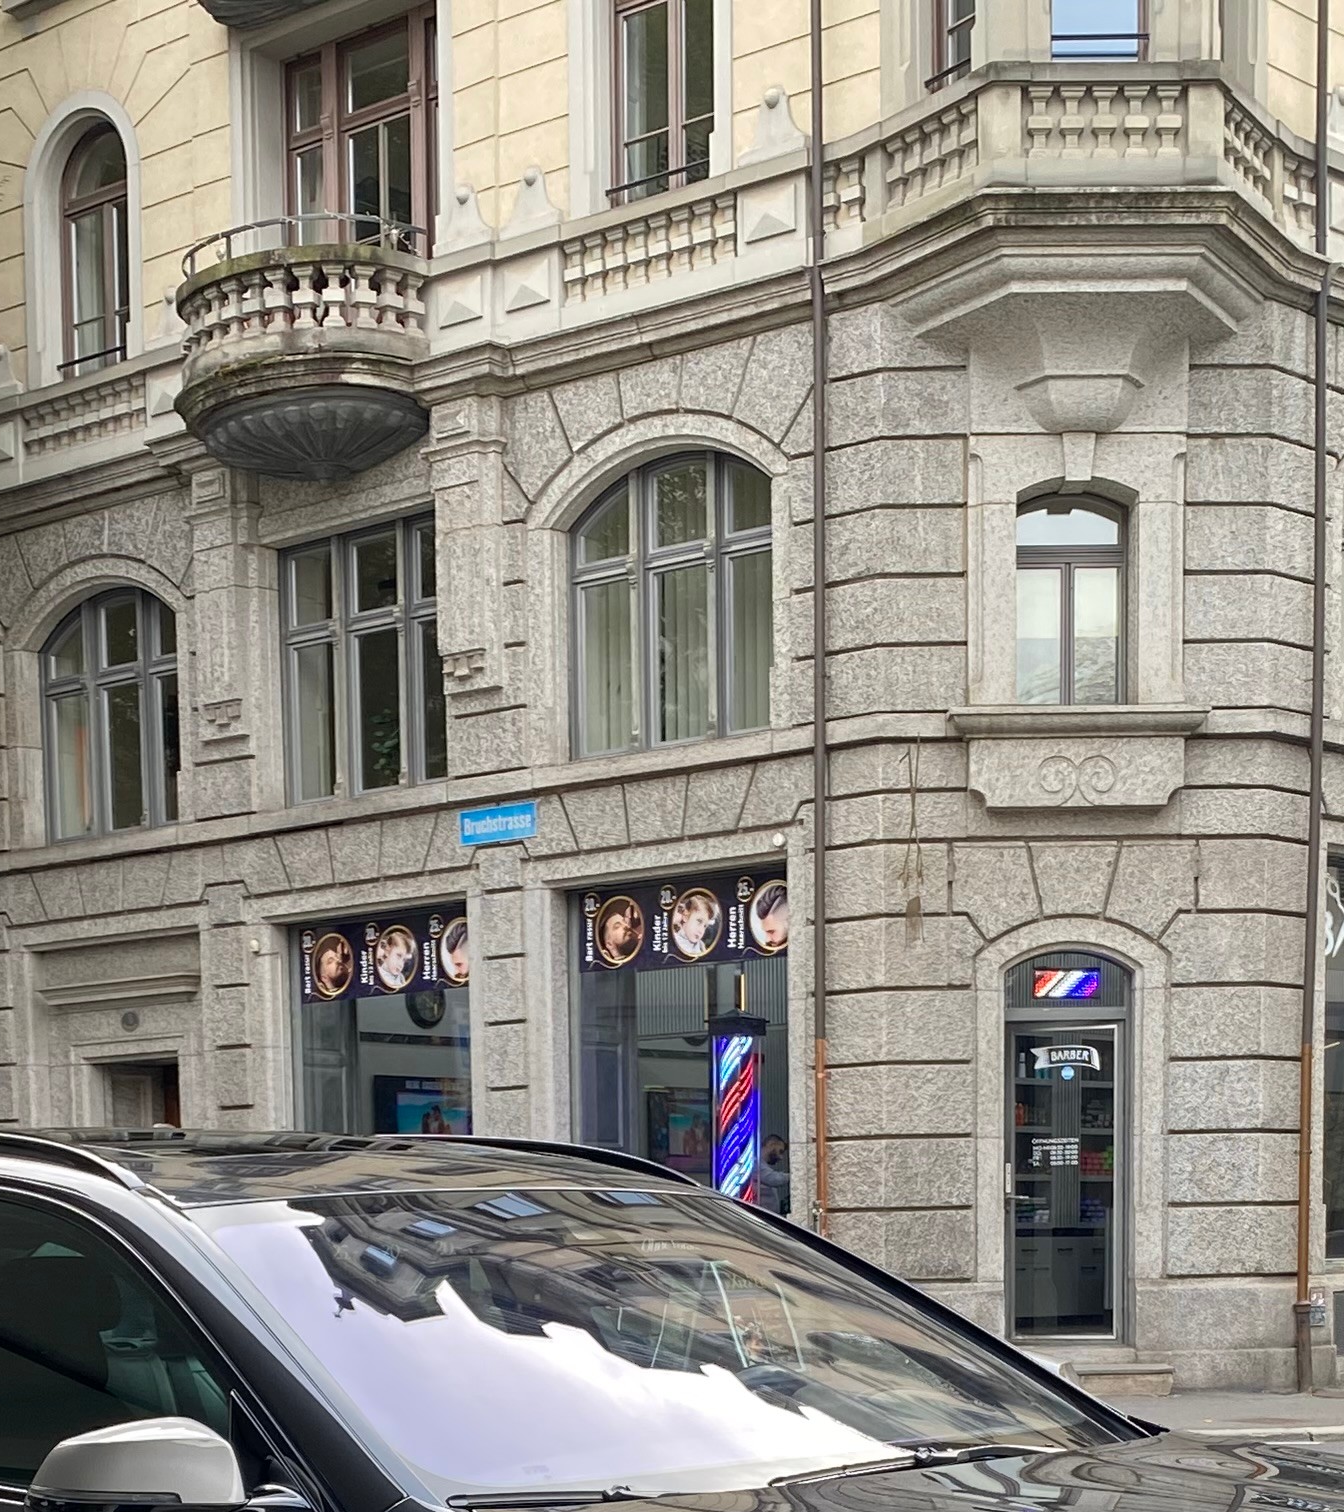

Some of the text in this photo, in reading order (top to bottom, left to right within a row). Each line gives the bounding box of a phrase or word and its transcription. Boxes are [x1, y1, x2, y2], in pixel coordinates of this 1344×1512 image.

[463, 814, 531, 836] Bruchstrasse
[652, 914, 662, 952] Kinder
[727, 906, 737, 948] Herren
[360, 950, 368, 984] Kinder
[422, 942, 431, 980] Herren
[1050, 1049, 1090, 1061] BARBER
